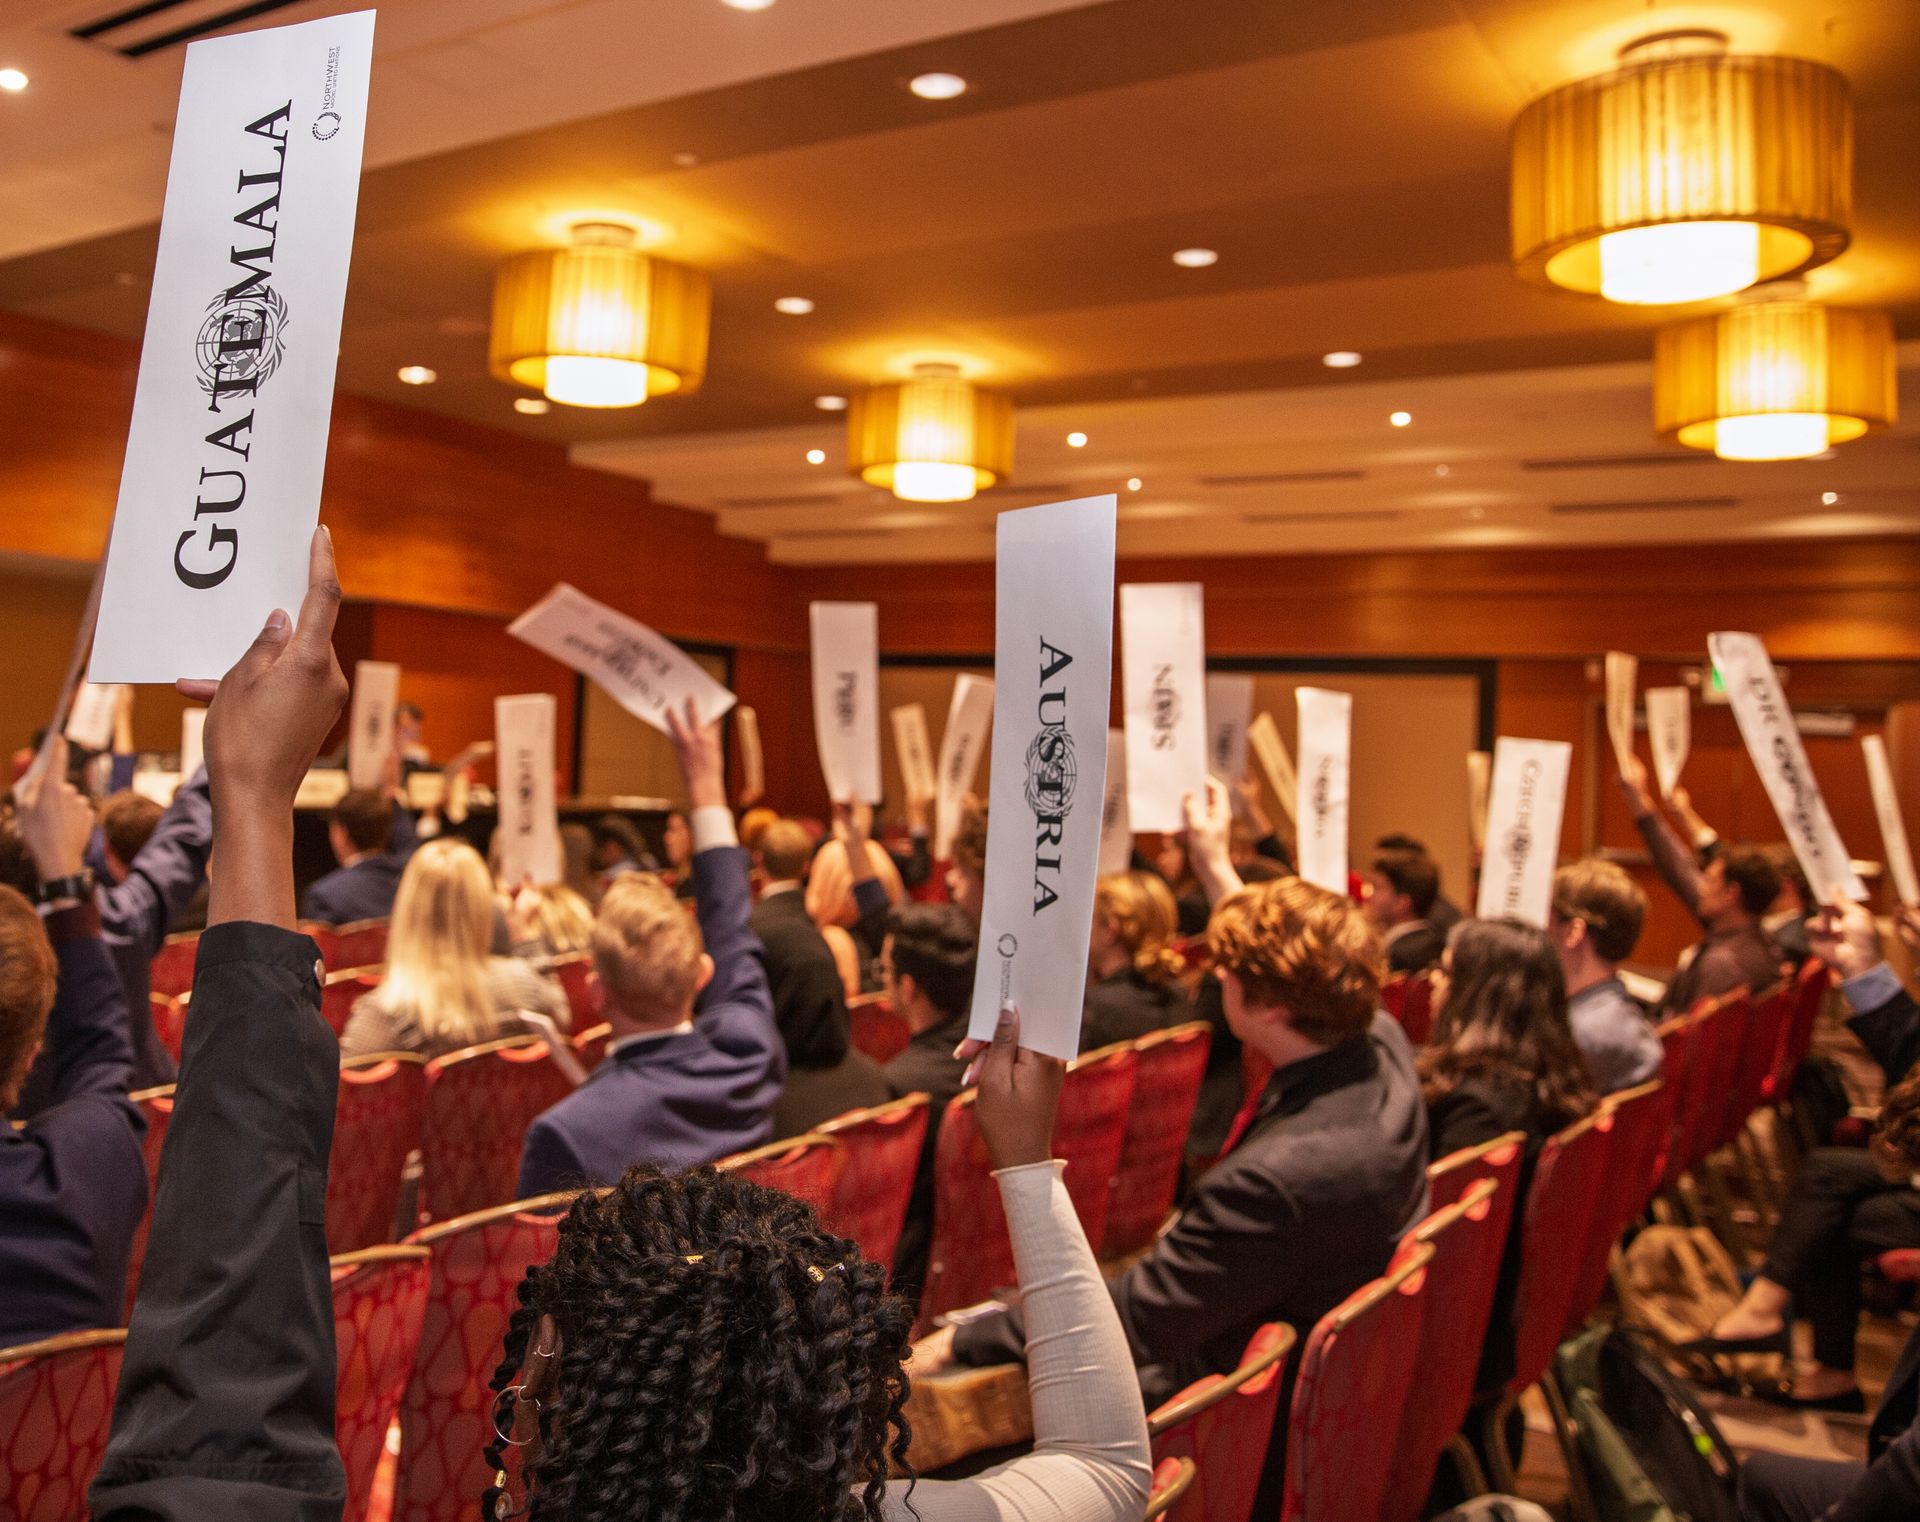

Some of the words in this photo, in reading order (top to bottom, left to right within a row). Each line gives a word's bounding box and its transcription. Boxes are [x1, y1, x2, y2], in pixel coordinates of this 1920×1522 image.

[322, 47, 335, 110] NORTHWEST
[174, 100, 292, 590] GUATEMALA
[1032, 635, 1074, 917] AUSTRIA
[1151, 663, 1176, 751] SPAIN
